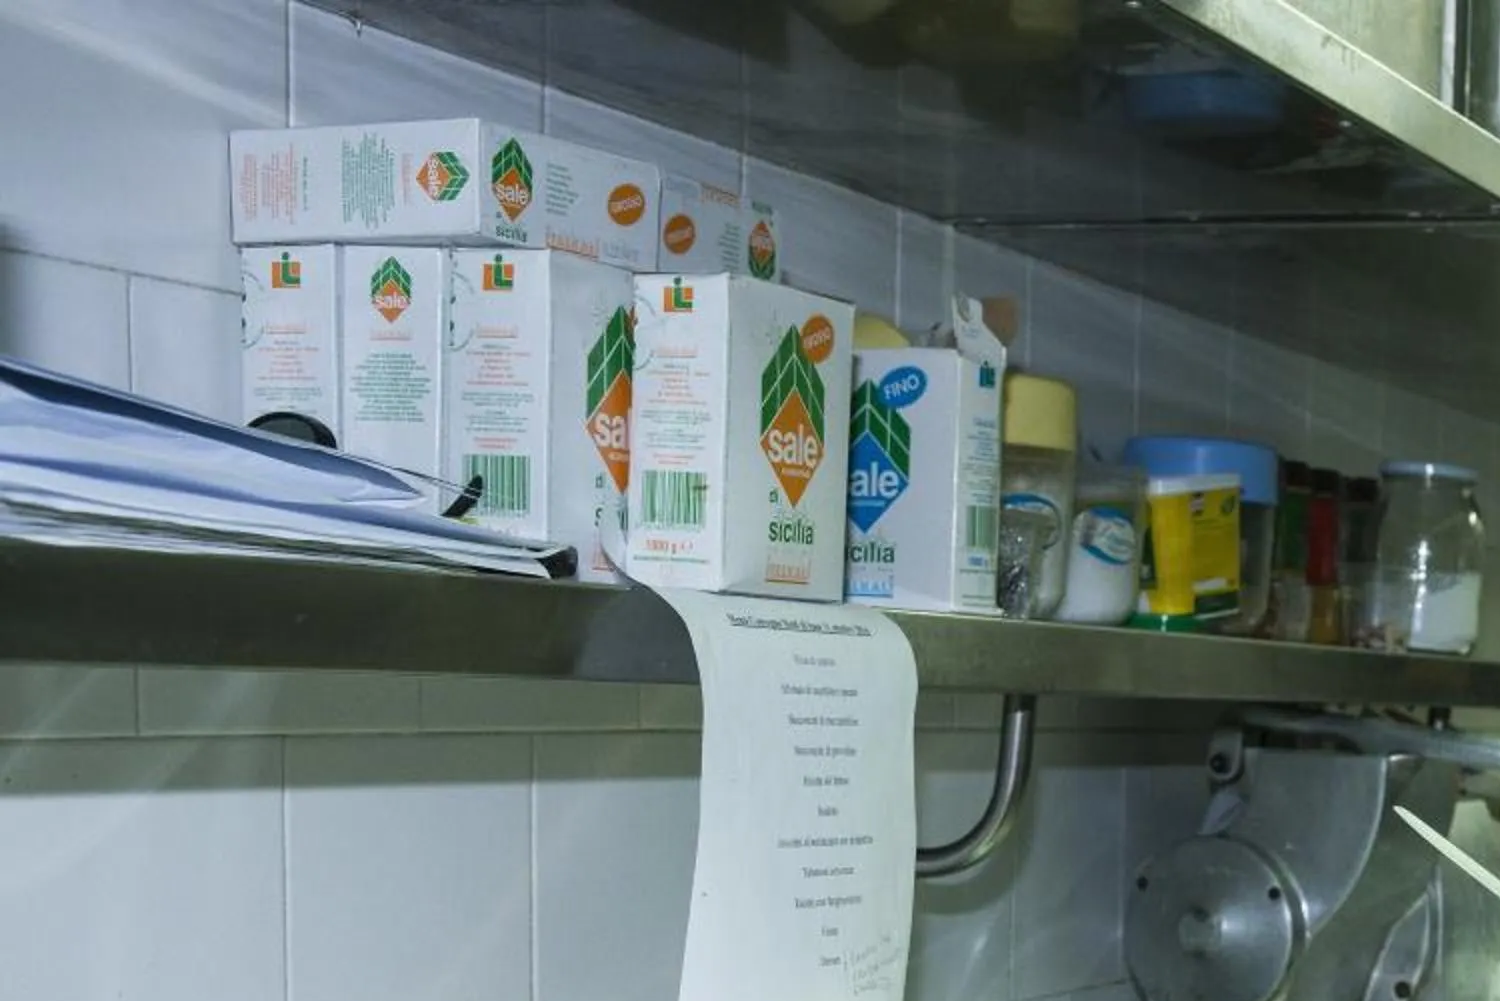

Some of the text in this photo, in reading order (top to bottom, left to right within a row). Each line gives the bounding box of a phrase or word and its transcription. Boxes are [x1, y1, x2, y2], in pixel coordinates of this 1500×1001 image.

[883, 374, 920, 400] FINO
[595, 413, 628, 449] sa
[768, 424, 818, 466] sale
[850, 461, 899, 498] ale
[768, 518, 814, 546] sicilia
